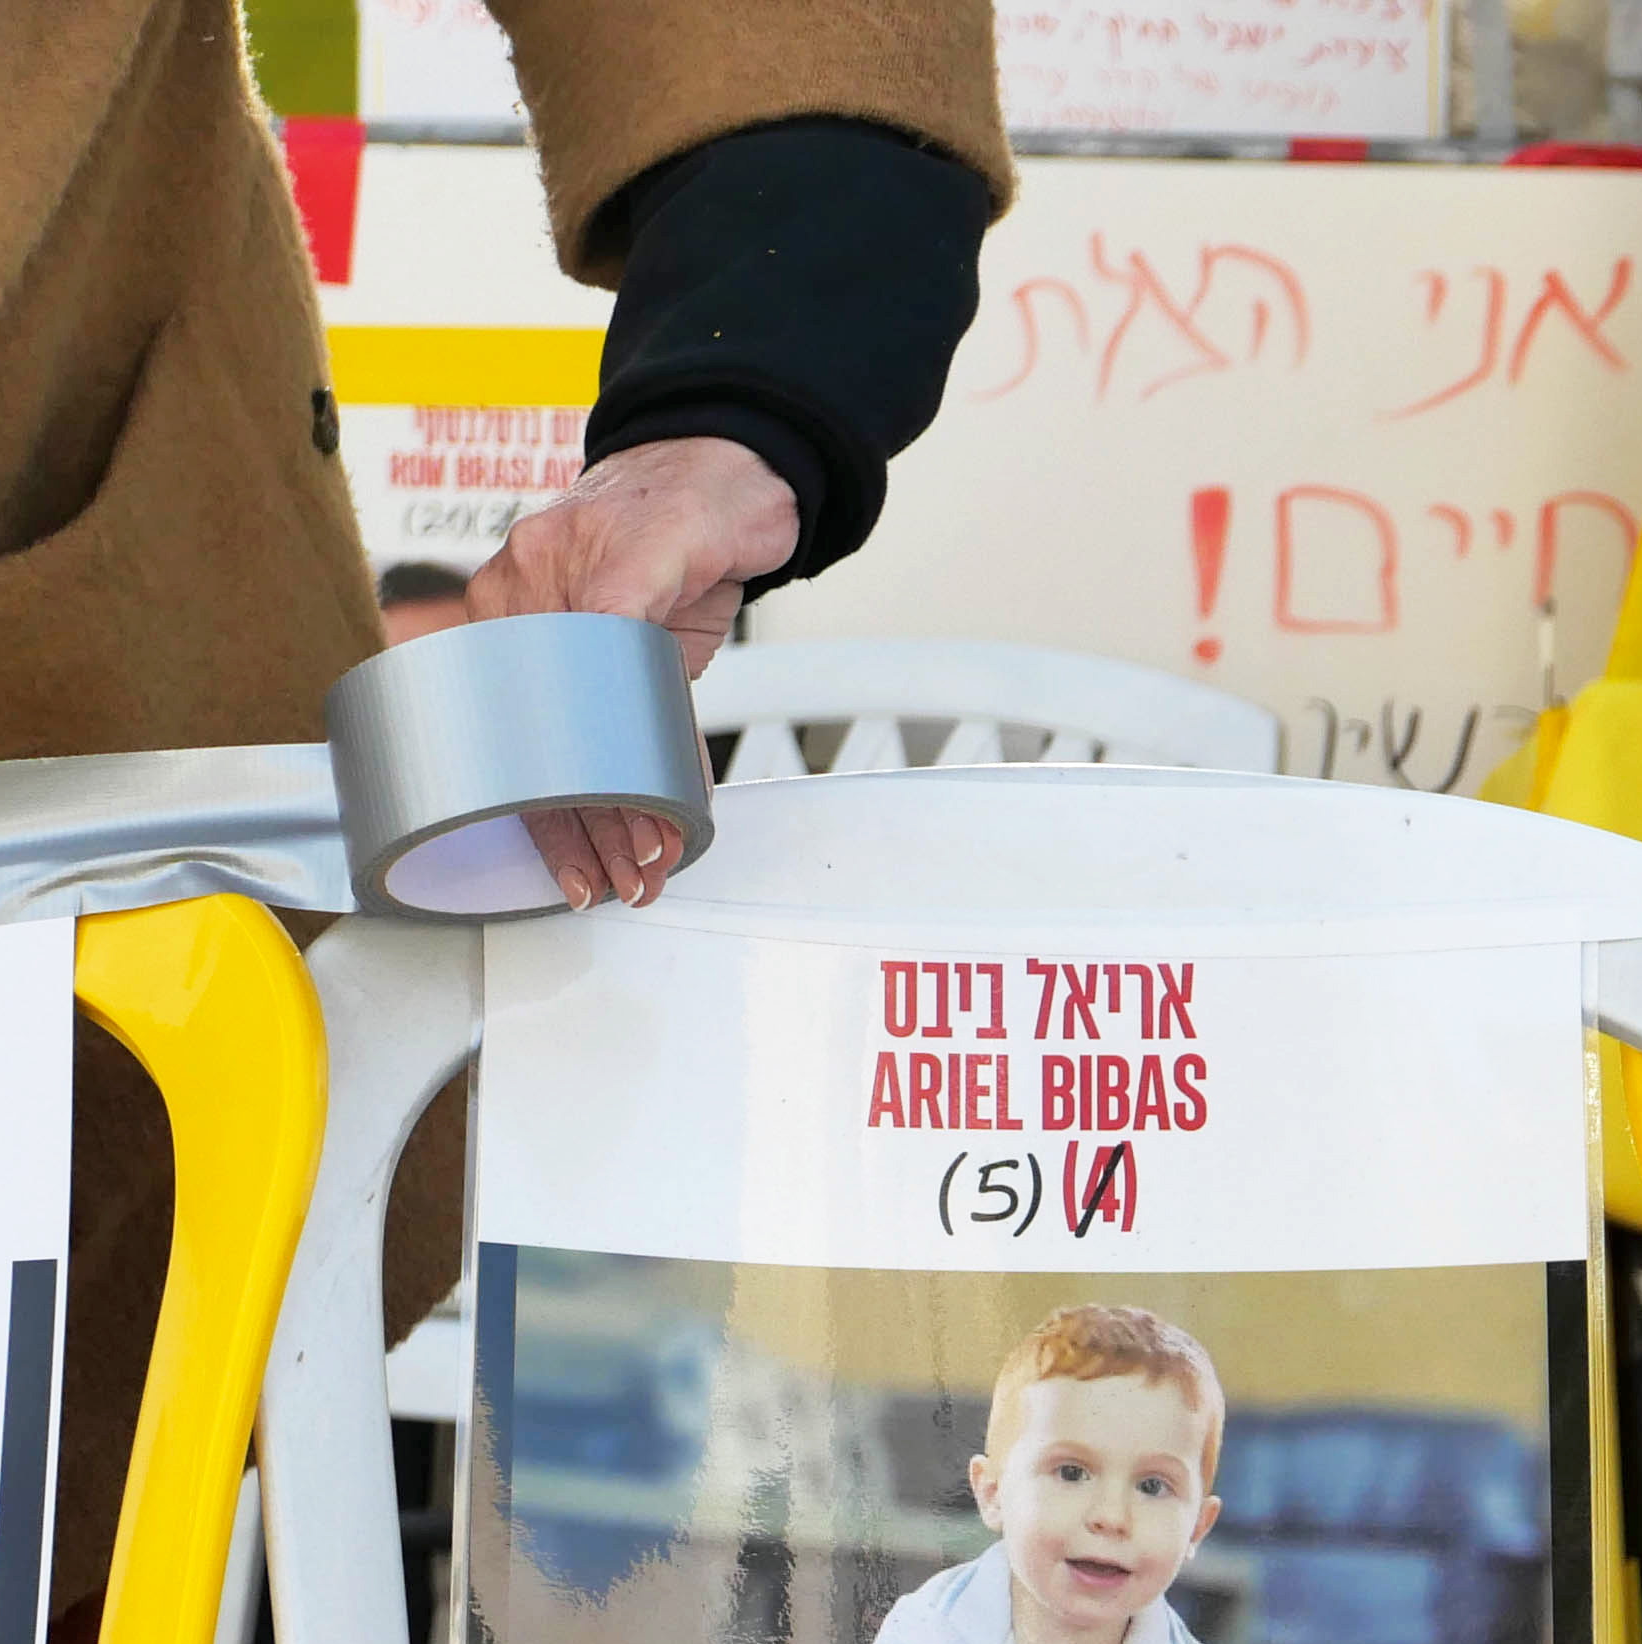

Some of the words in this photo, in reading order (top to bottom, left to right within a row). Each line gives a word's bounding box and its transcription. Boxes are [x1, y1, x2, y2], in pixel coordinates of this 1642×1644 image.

[1374, 256, 1634, 424] אני
[880, 960, 1008, 1040] ביבס
[1026, 957, 1198, 1040] אריאל
[867, 1050, 1024, 1131] ARIEL
[1041, 1052, 1208, 1132] BIBAS
[938, 1151, 1043, 1238] (5)
